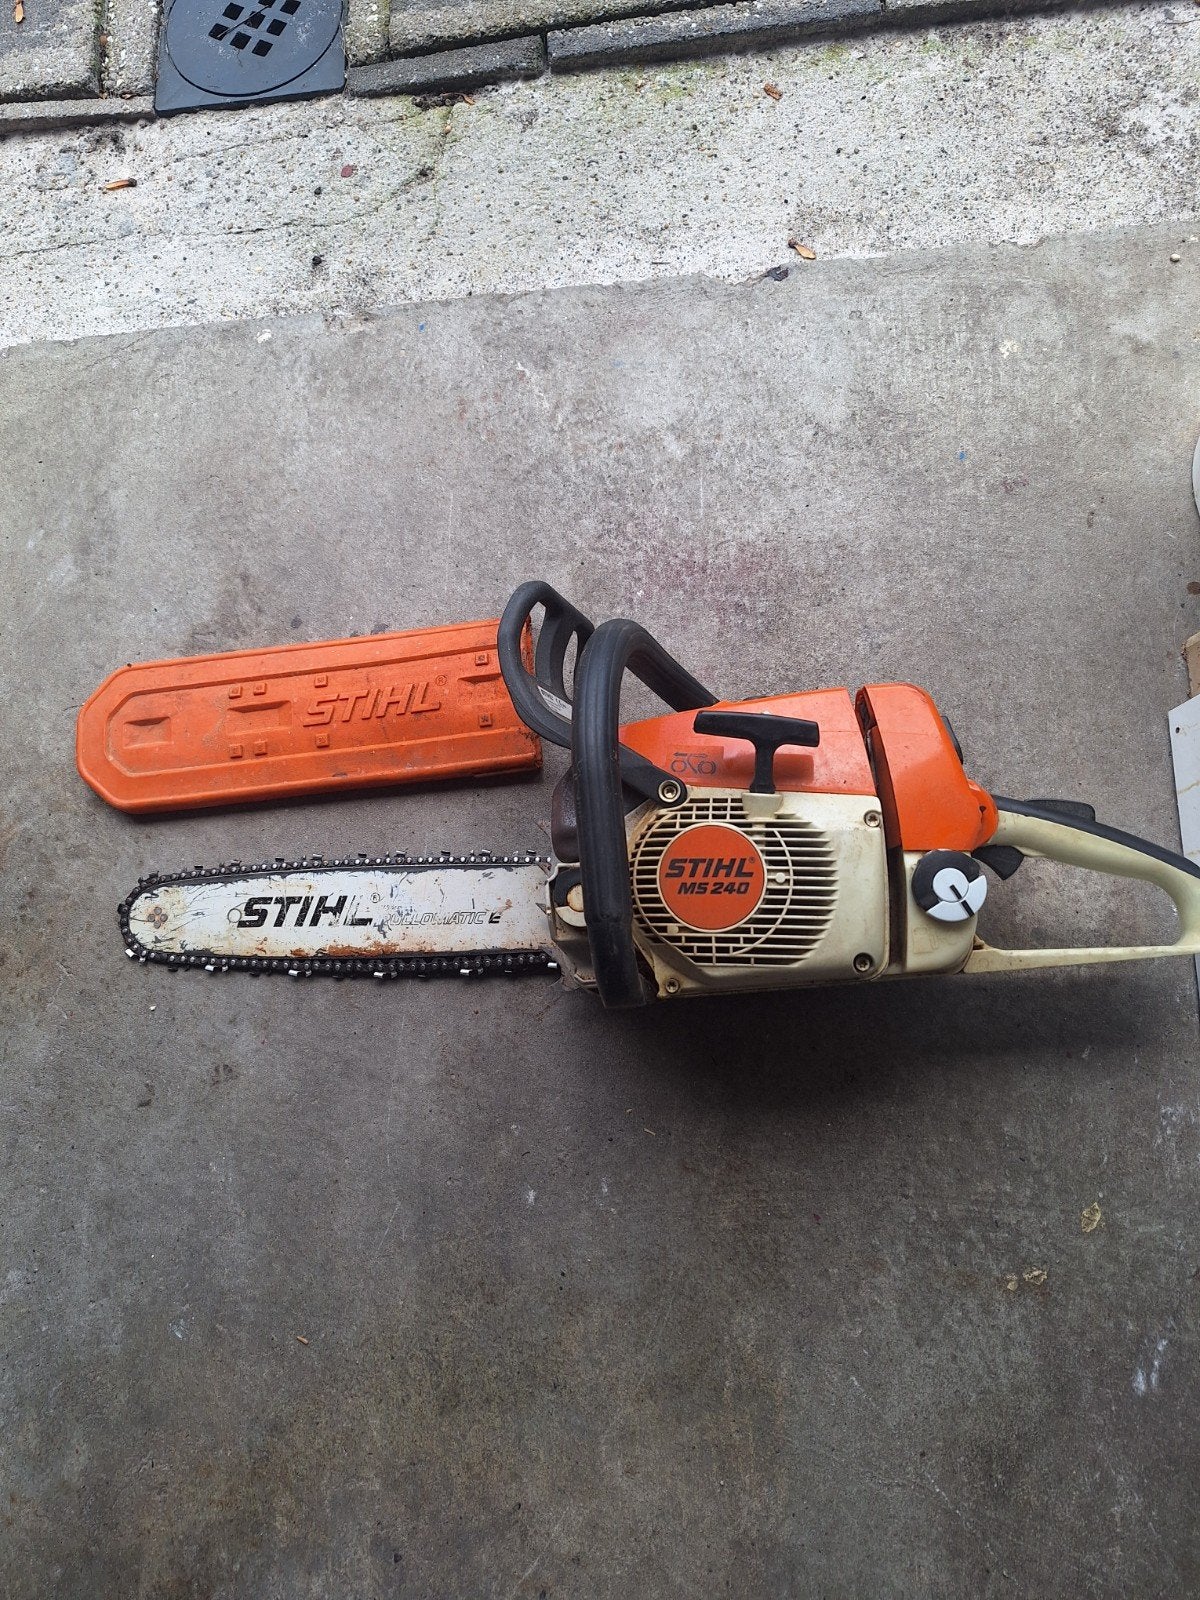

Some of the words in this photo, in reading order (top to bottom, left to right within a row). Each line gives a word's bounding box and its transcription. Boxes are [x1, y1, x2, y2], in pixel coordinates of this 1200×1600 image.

[303, 682, 441, 727] STIHL
[665, 858, 754, 878] STIHL
[677, 882, 709, 895] MS
[710, 882, 750, 895] 240
[237, 895, 373, 928] STIHL
